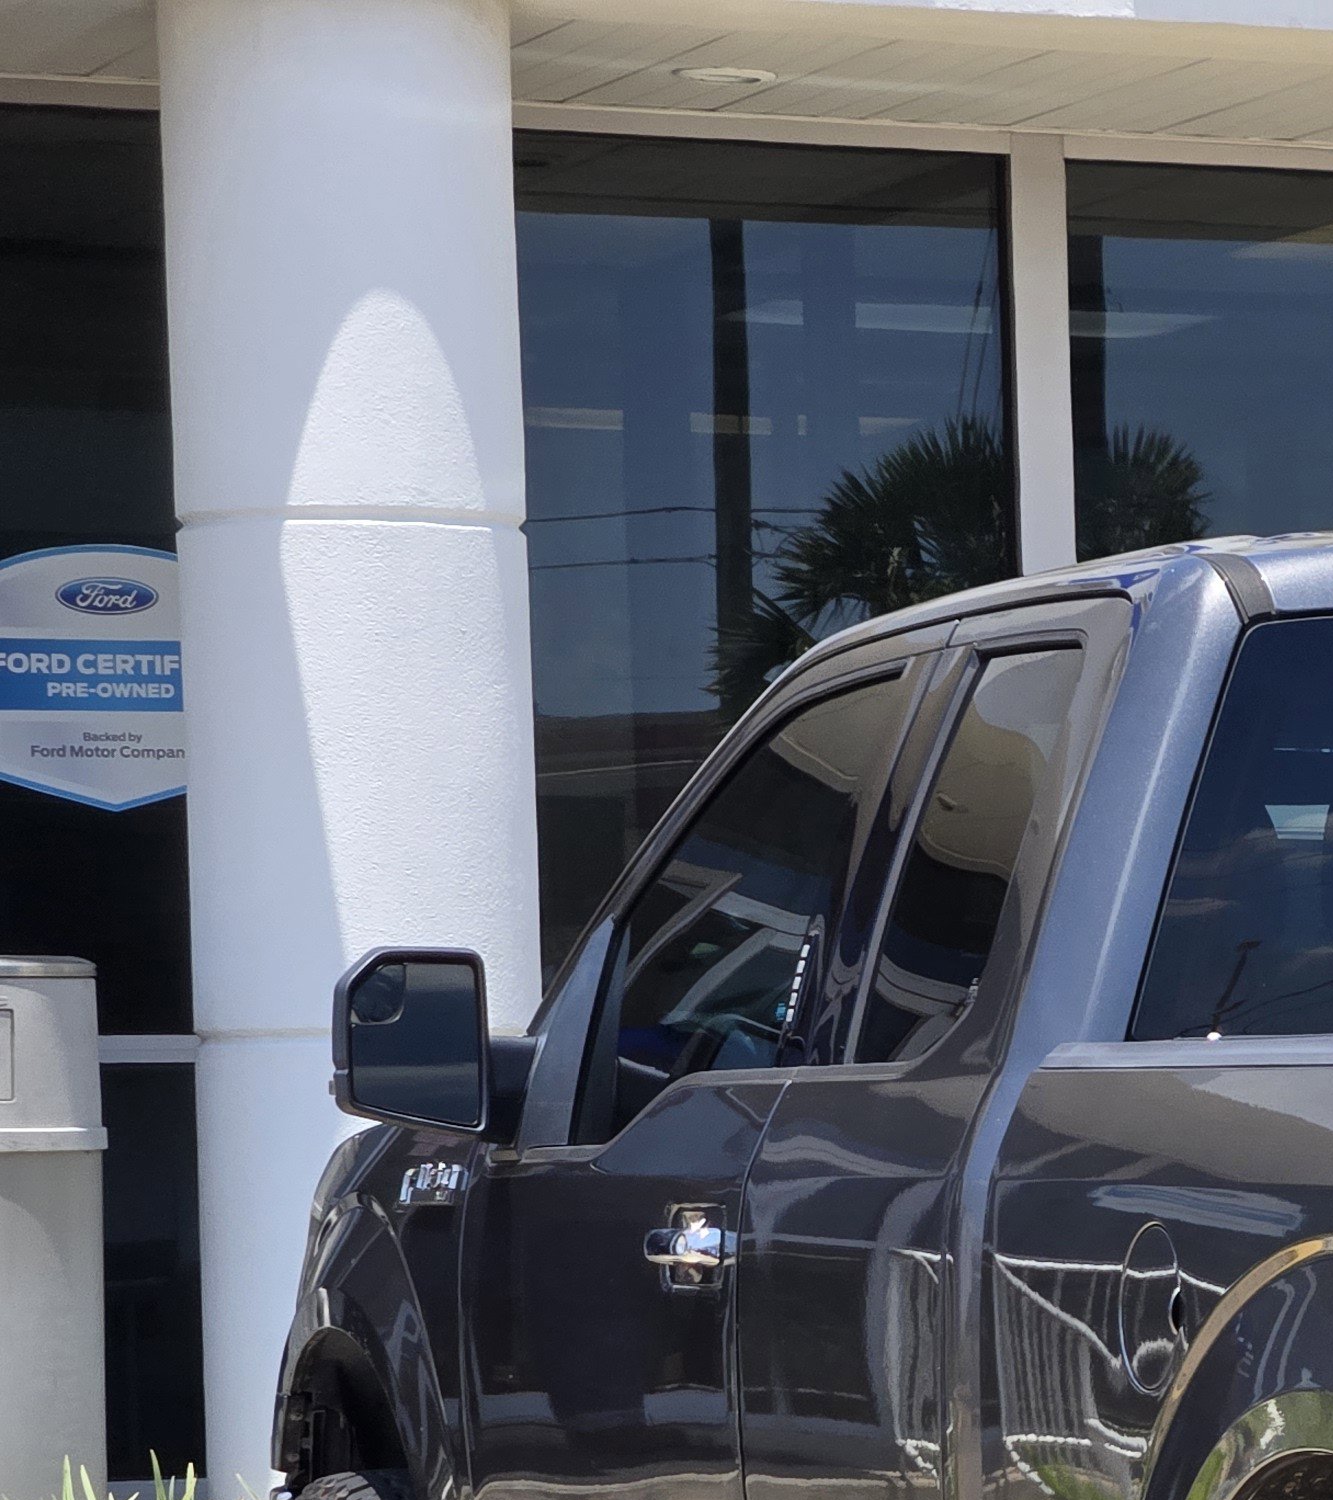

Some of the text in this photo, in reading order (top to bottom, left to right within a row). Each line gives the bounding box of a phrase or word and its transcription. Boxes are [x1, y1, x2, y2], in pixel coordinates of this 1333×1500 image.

[76, 582, 137, 608] Ford
[47, 682, 175, 698] PRE-OWNED
[83, 731, 142, 743] Backed by
[31, 744, 66, 758] Ford
[70, 744, 116, 758] Motor
